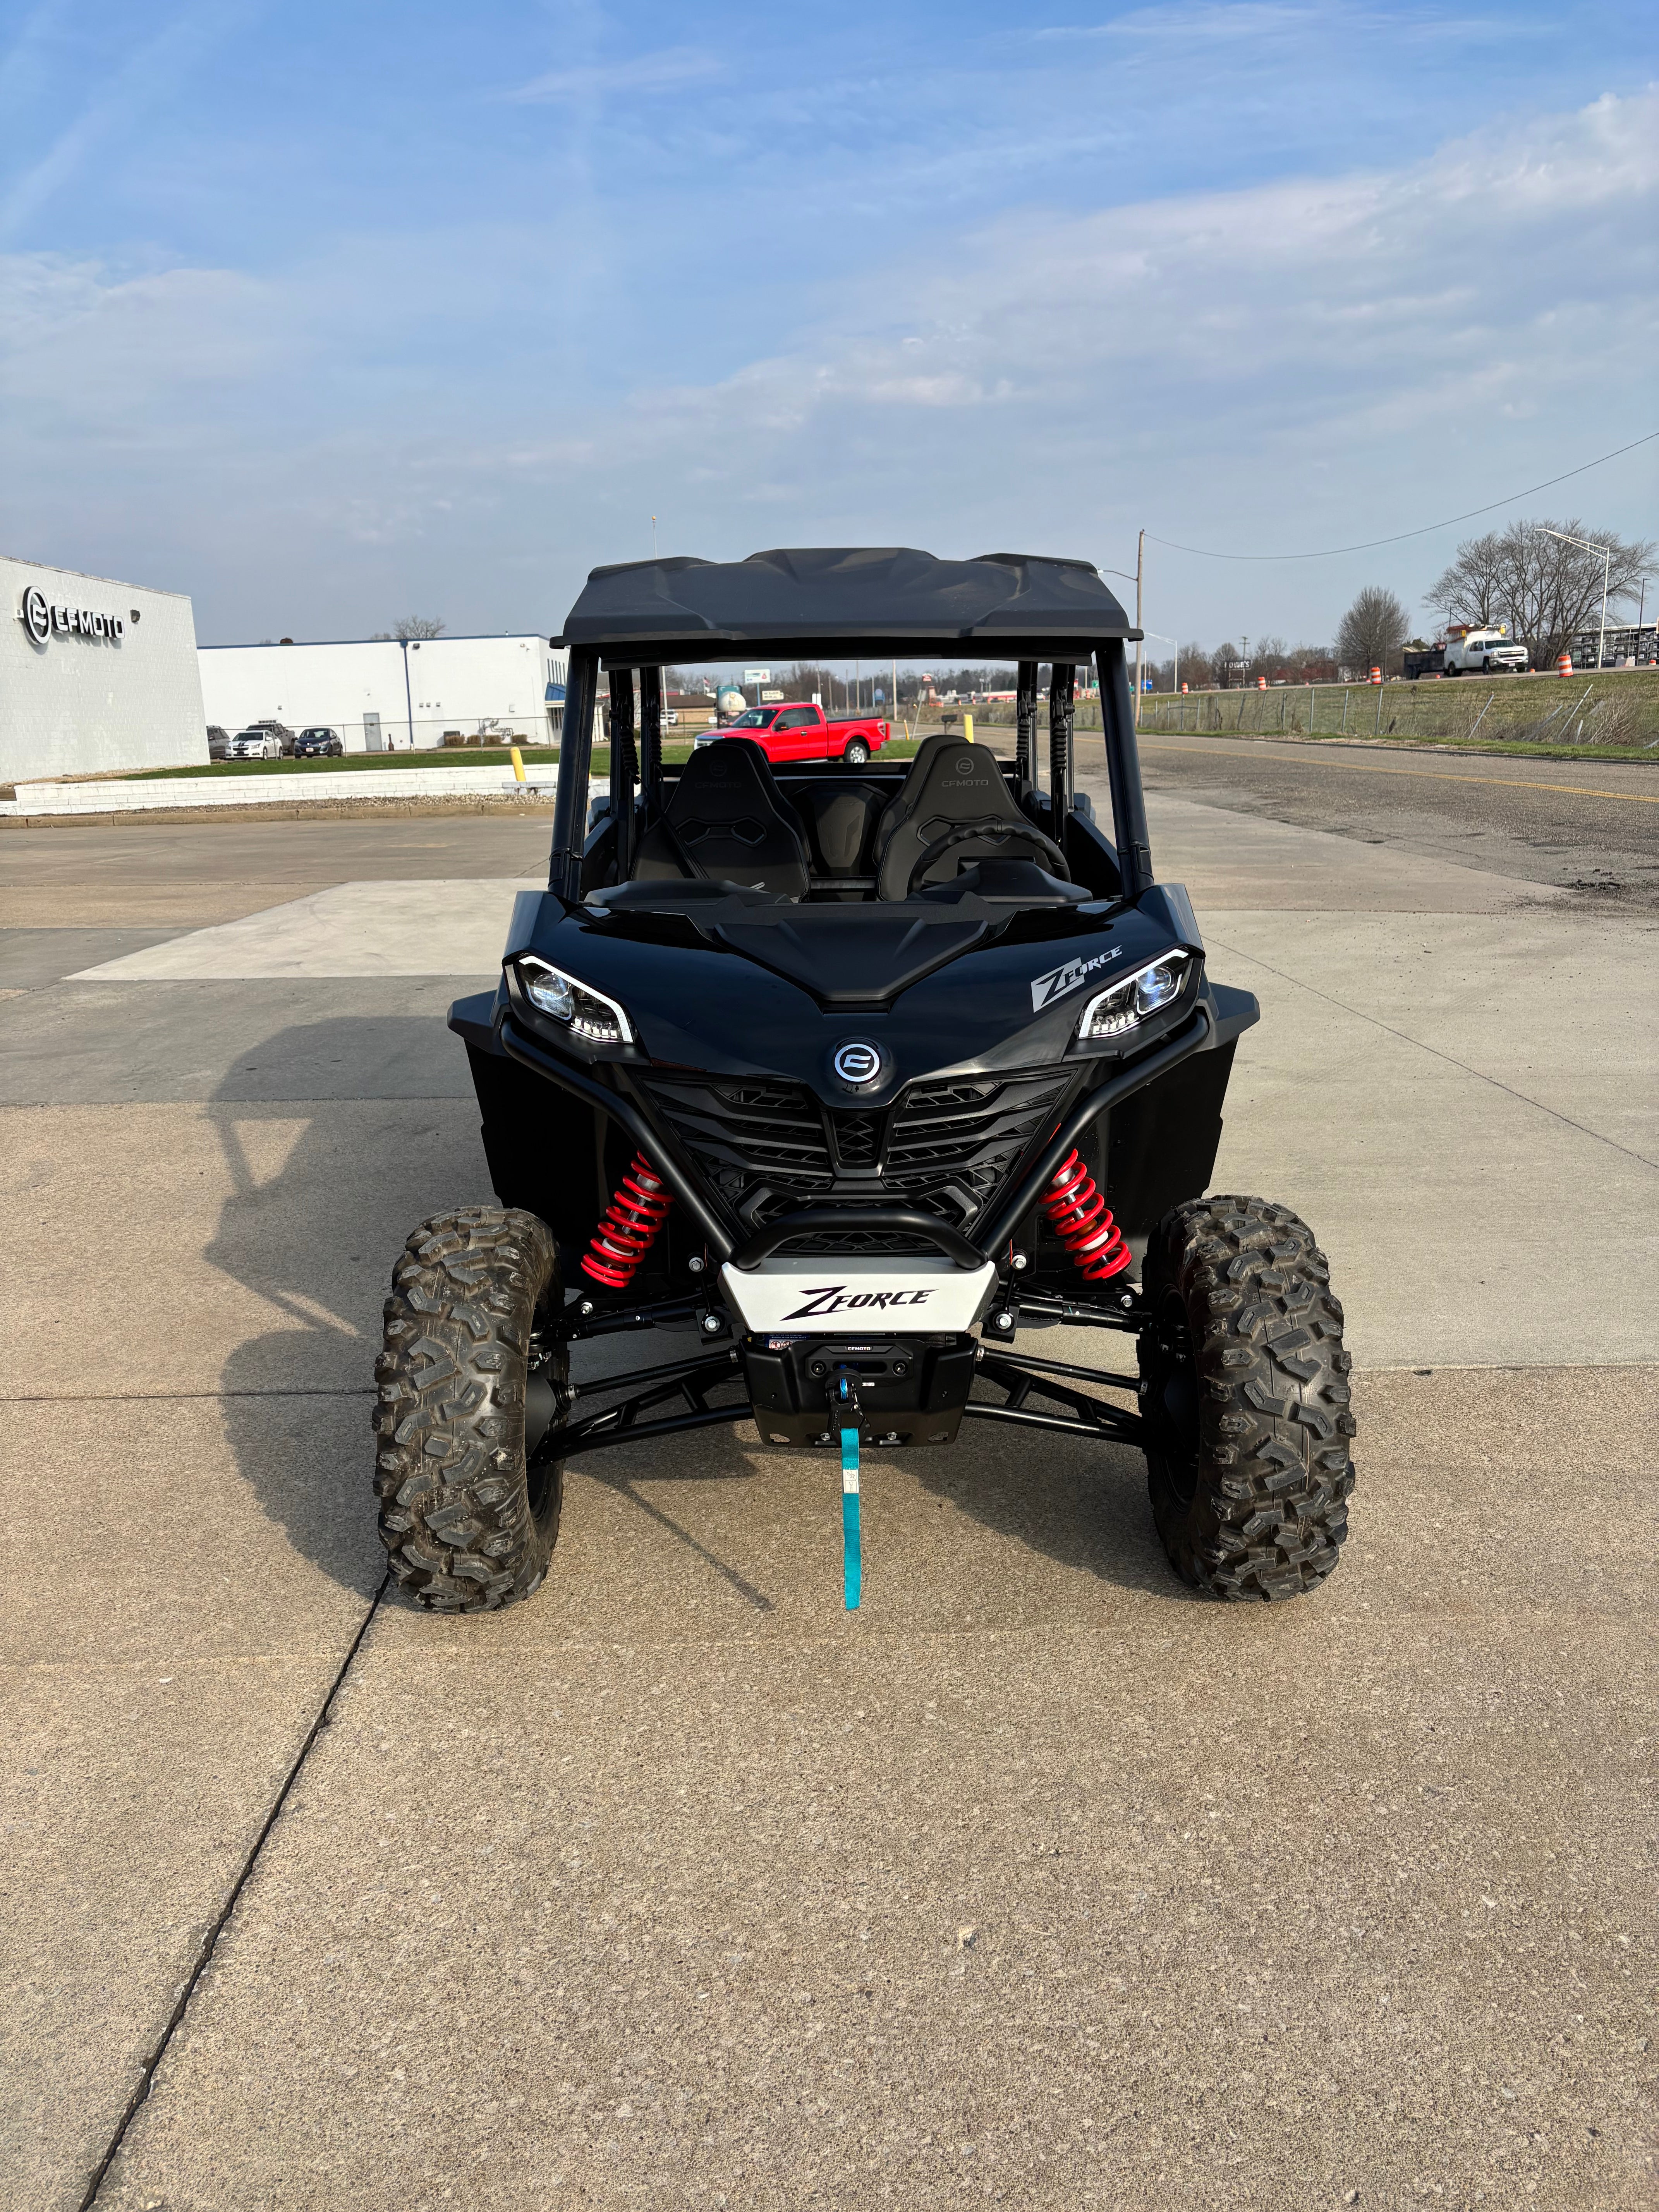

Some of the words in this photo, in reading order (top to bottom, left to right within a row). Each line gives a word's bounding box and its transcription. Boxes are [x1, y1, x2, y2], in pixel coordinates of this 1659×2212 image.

[52, 605, 125, 639] CFMOTO
[1035, 945, 1122, 1006] ZFORCE
[779, 1285, 940, 1321] ZFORCE
